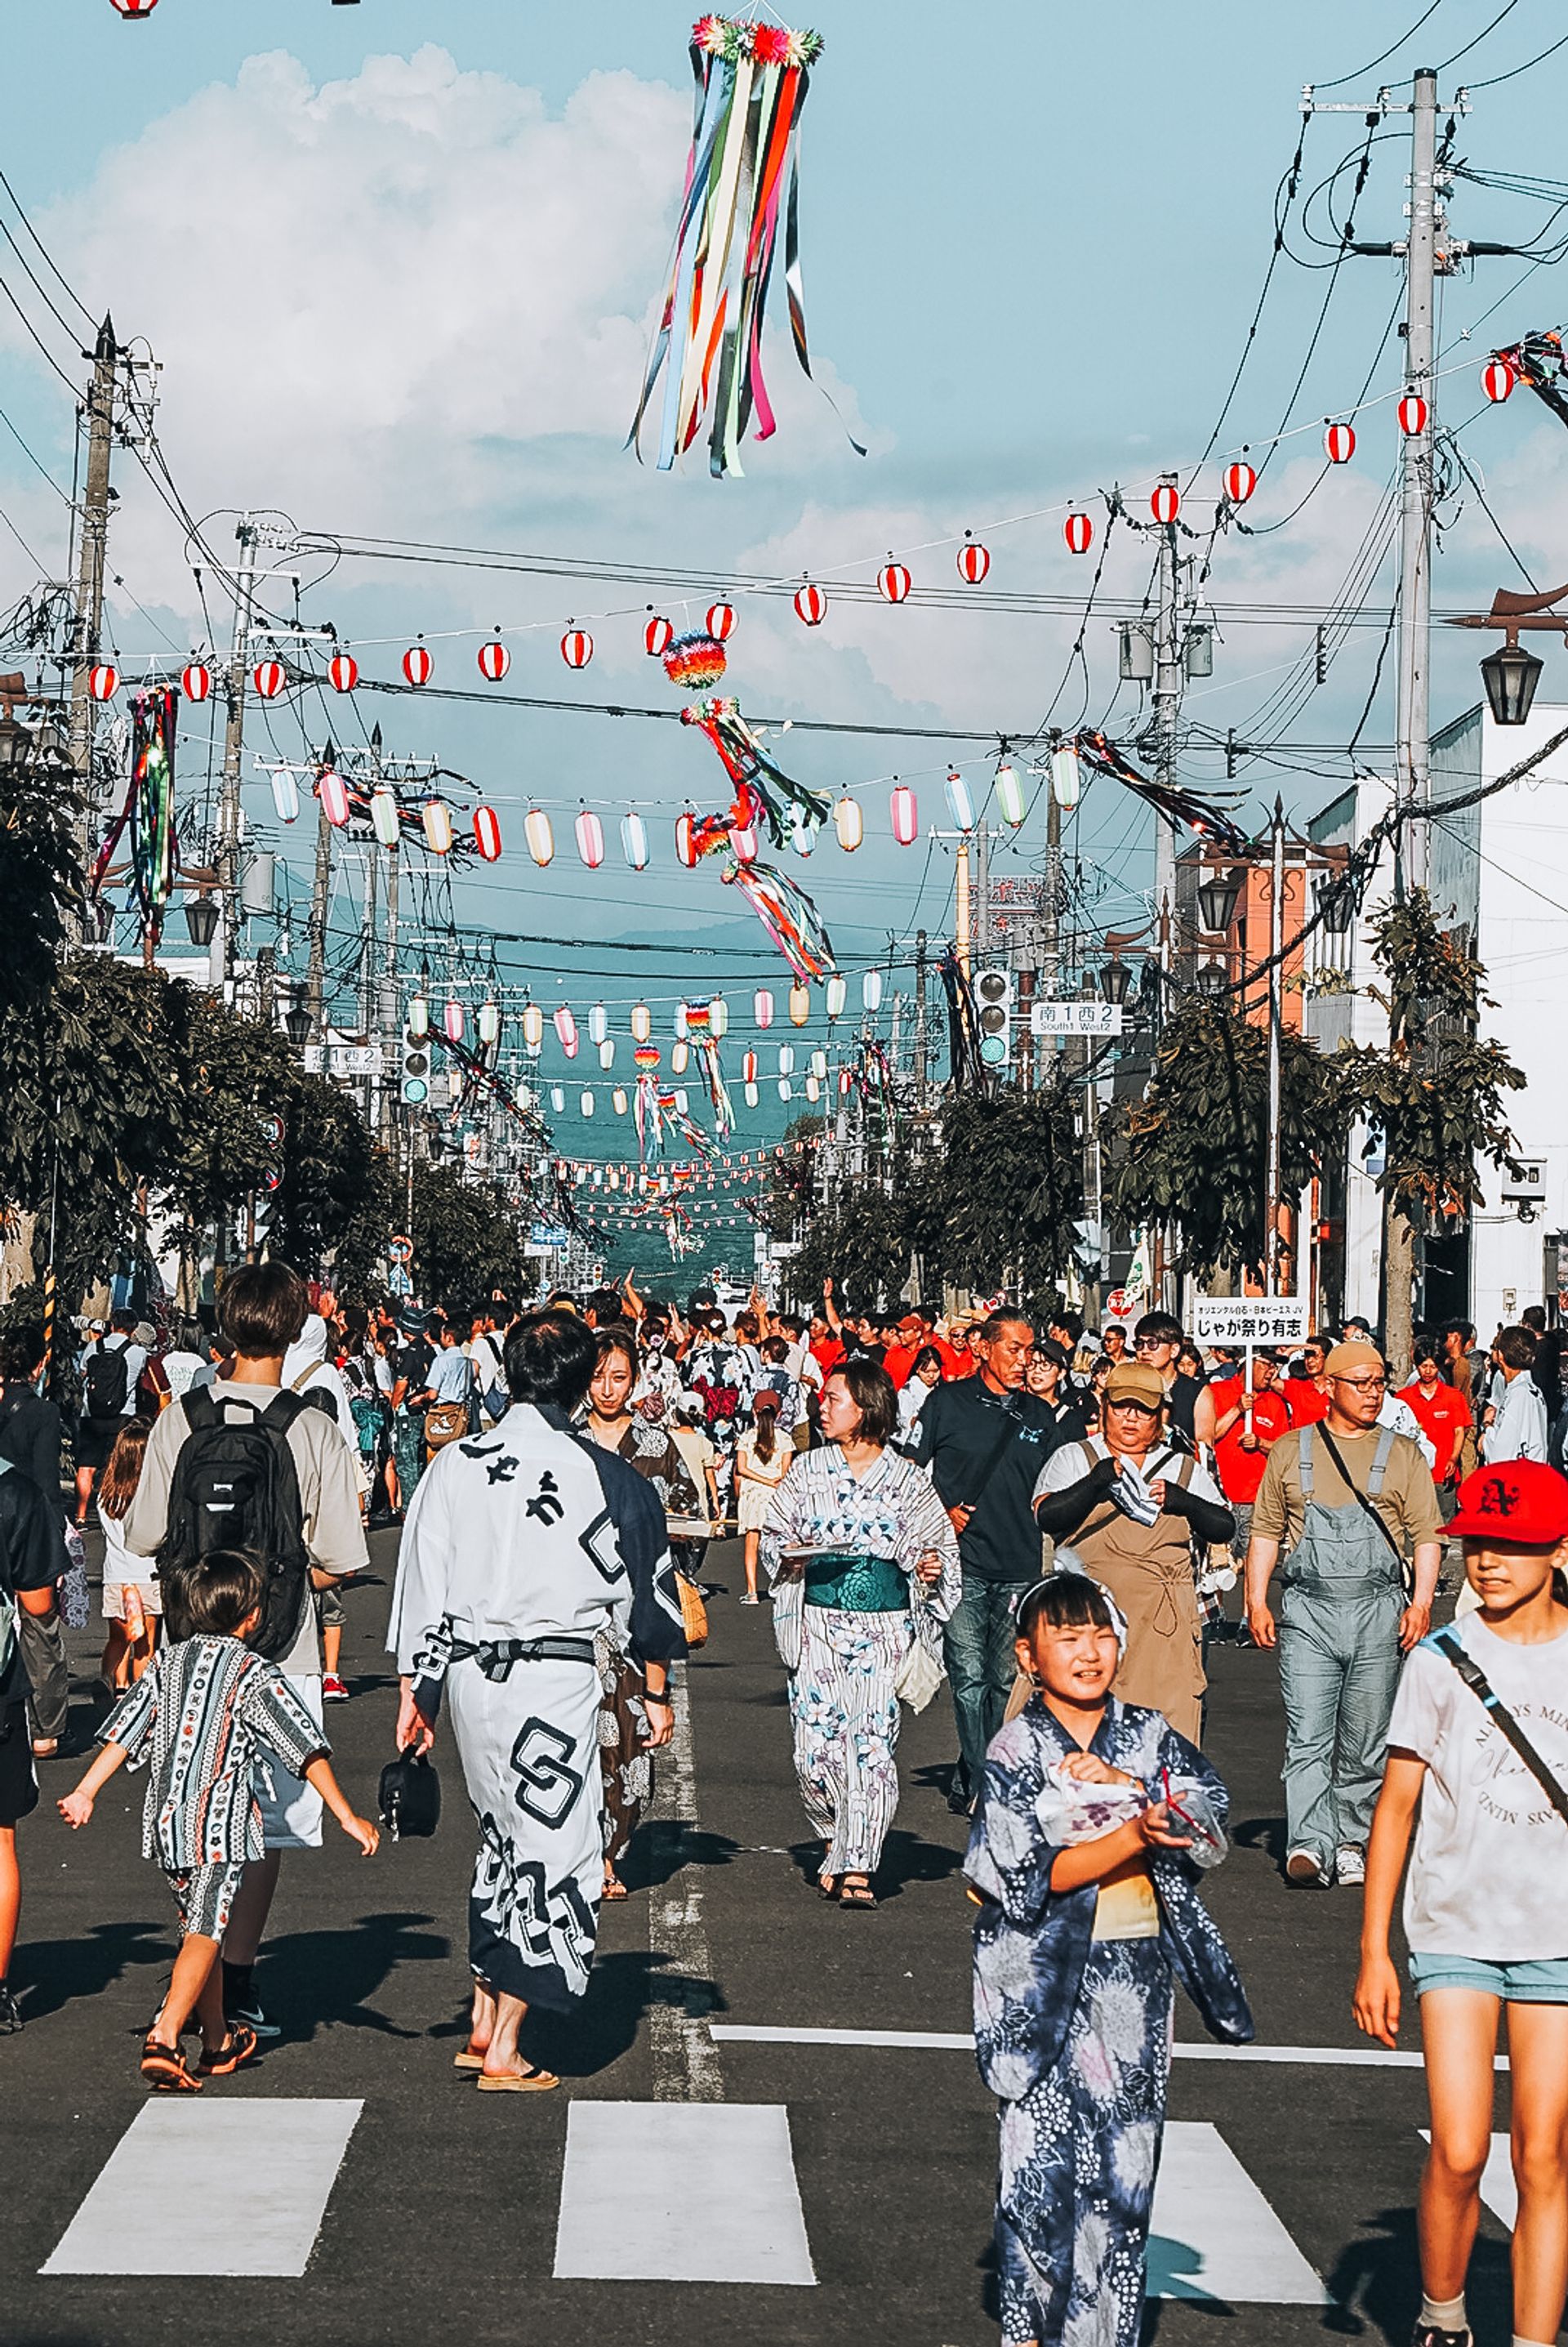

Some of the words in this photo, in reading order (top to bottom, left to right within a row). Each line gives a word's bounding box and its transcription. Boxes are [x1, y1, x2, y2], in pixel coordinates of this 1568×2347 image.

[1198, 1319, 1302, 1337] じゃが祭り有志
